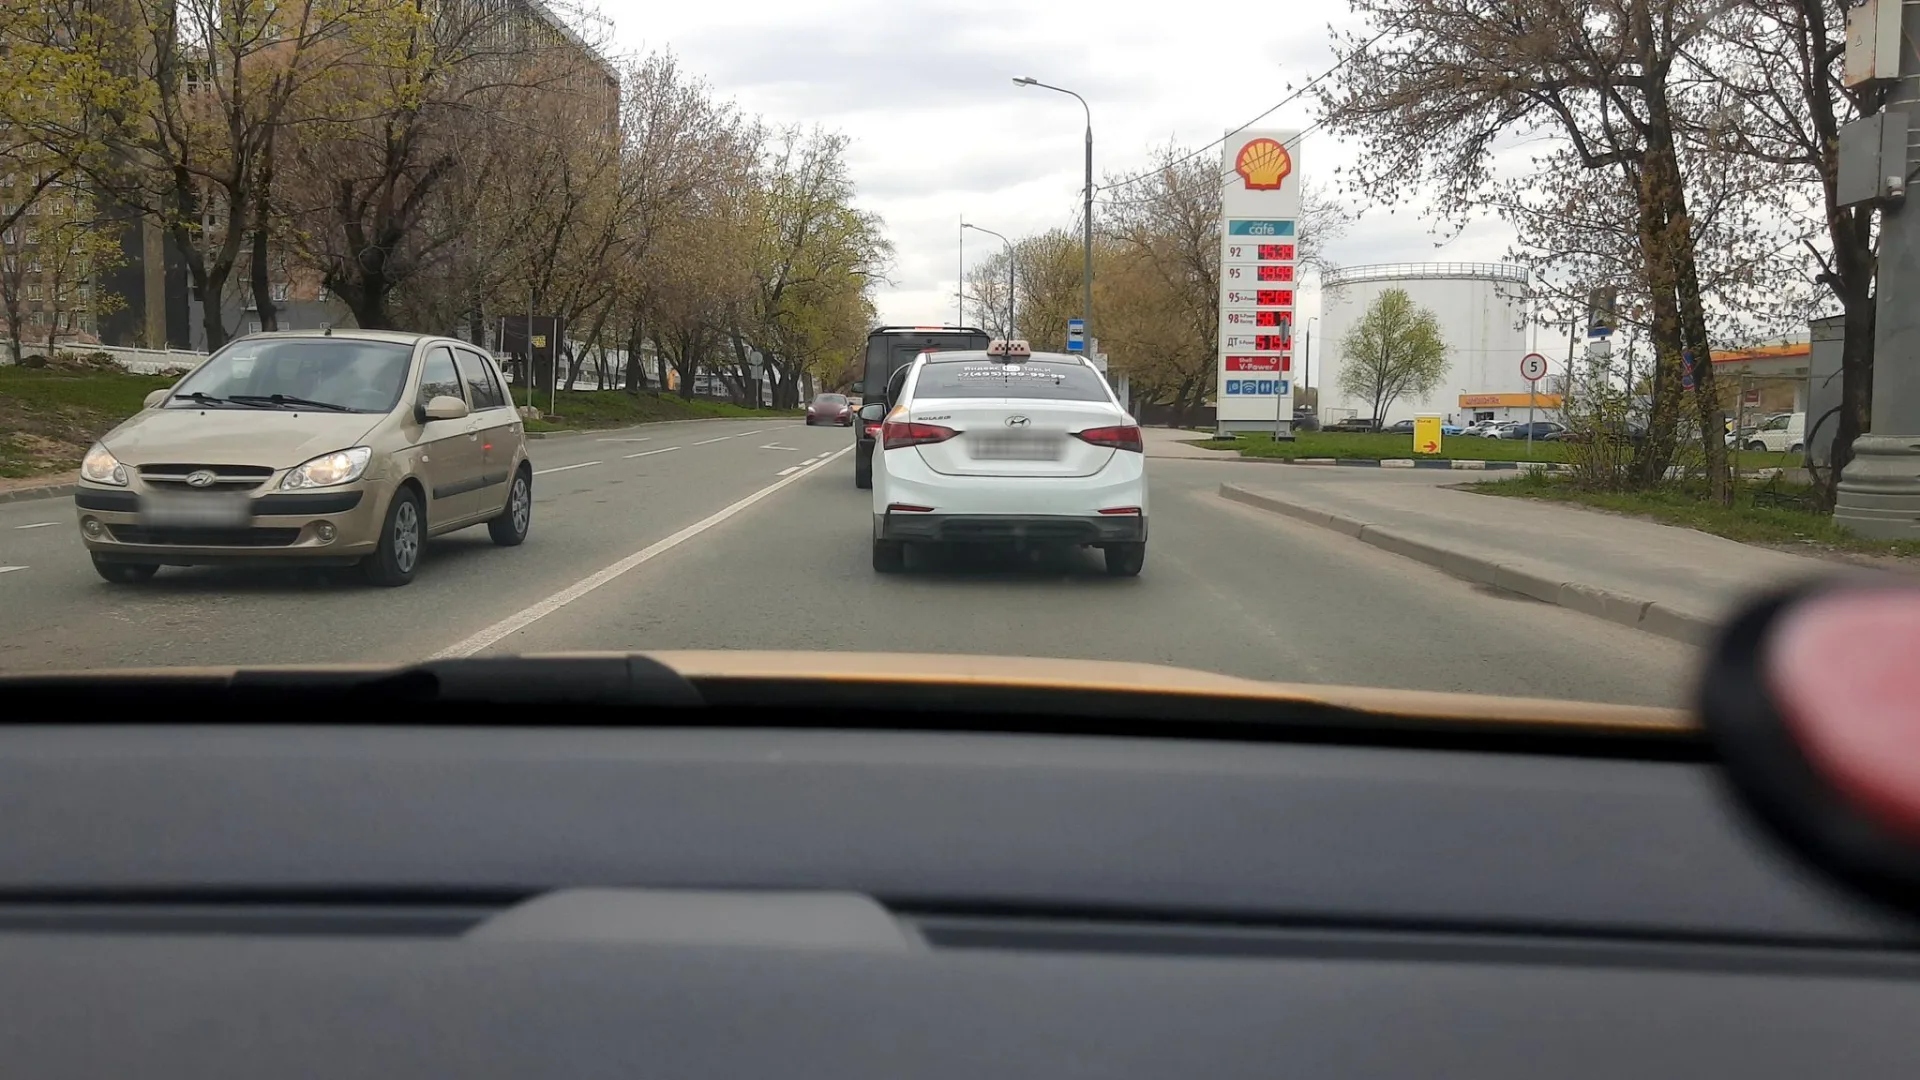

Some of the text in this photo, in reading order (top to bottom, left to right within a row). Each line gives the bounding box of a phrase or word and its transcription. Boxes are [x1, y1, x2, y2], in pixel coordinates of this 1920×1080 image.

[1248, 223, 1275, 235] café
[1229, 247, 1242, 257] 92
[1229, 268, 1241, 278] 95
[1228, 292, 1240, 303] 95
[1228, 313, 1240, 324] 98
[1227, 337, 1239, 347] ДТ
[1530, 361, 1538, 372] 5
